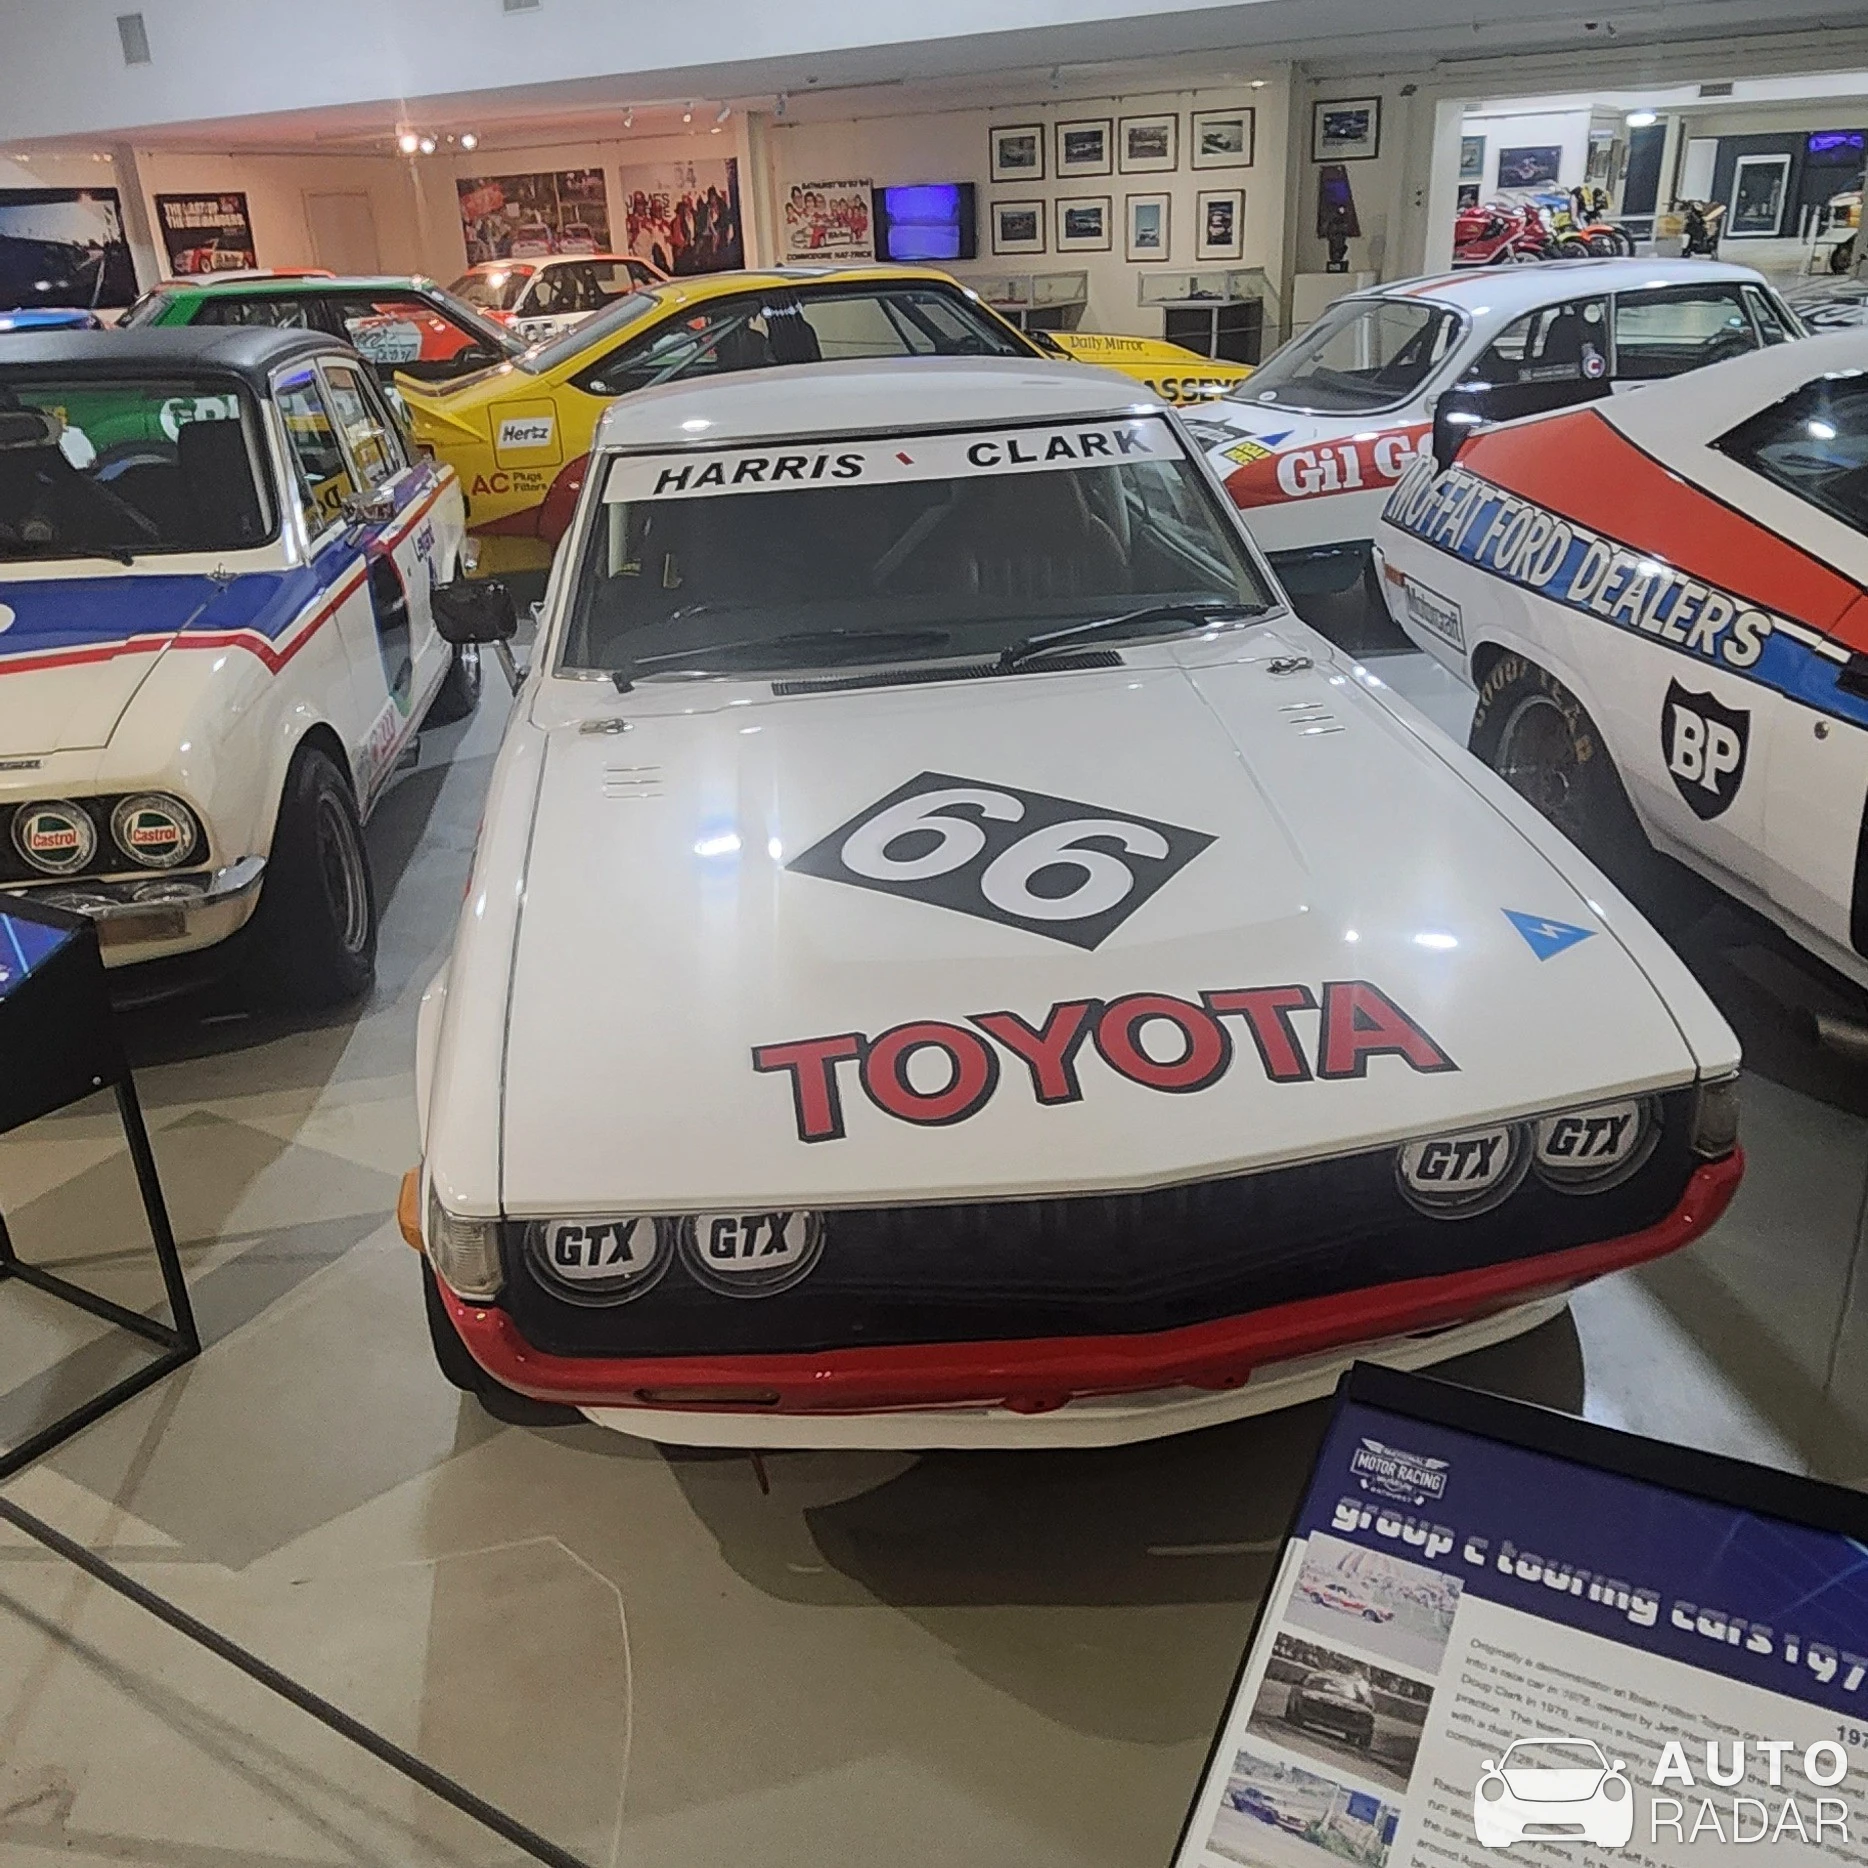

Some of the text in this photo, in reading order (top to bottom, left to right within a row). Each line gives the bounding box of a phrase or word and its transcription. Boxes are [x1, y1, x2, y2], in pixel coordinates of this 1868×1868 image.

[1070, 336, 1145, 351] Daily Mirror
[502, 425, 549, 441] Hertz
[471, 472, 510, 496] AC
[513, 472, 543, 481] Plugs
[653, 453, 866, 495] HARRIS
[967, 428, 1154, 467] CLARK
[1277, 445, 1363, 496] Gil
[513, 482, 547, 492] Filters
[1386, 456, 1773, 668] MOFFAT FORD DEALERS
[1669, 703, 1741, 795] BP
[33, 831, 77, 847] Castrol
[133, 827, 176, 842] Castrol
[841, 788, 1170, 921] 66
[752, 980, 1462, 1143] TOYOTA
[1416, 1135, 1502, 1181] GTX
[1545, 1114, 1632, 1156] GTX
[555, 1218, 640, 1267] GTX
[709, 1212, 794, 1259] GTX
[1358, 1453, 1441, 1490] MOTOR RACING
[1331, 1497, 1453, 1557] group
[1497, 1540, 1661, 1626] touring
[1671, 1600, 1773, 1655] cars
